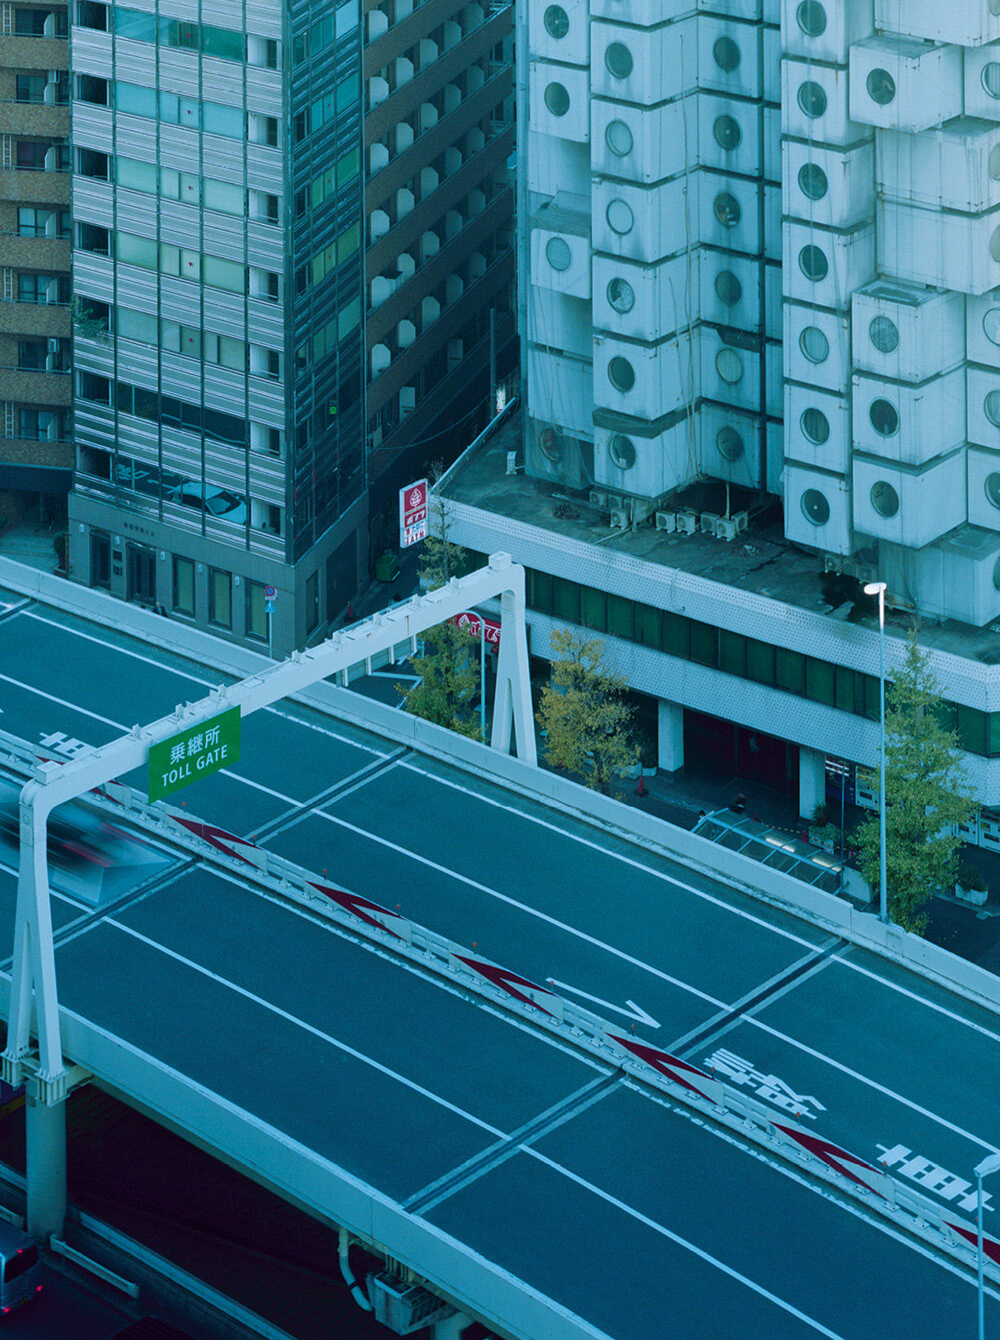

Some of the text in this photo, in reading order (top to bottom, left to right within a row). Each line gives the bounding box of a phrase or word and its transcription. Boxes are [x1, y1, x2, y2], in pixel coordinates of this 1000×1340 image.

[162, 744, 228, 787] TOLL GATE
[169, 724, 221, 765] 乗継所
